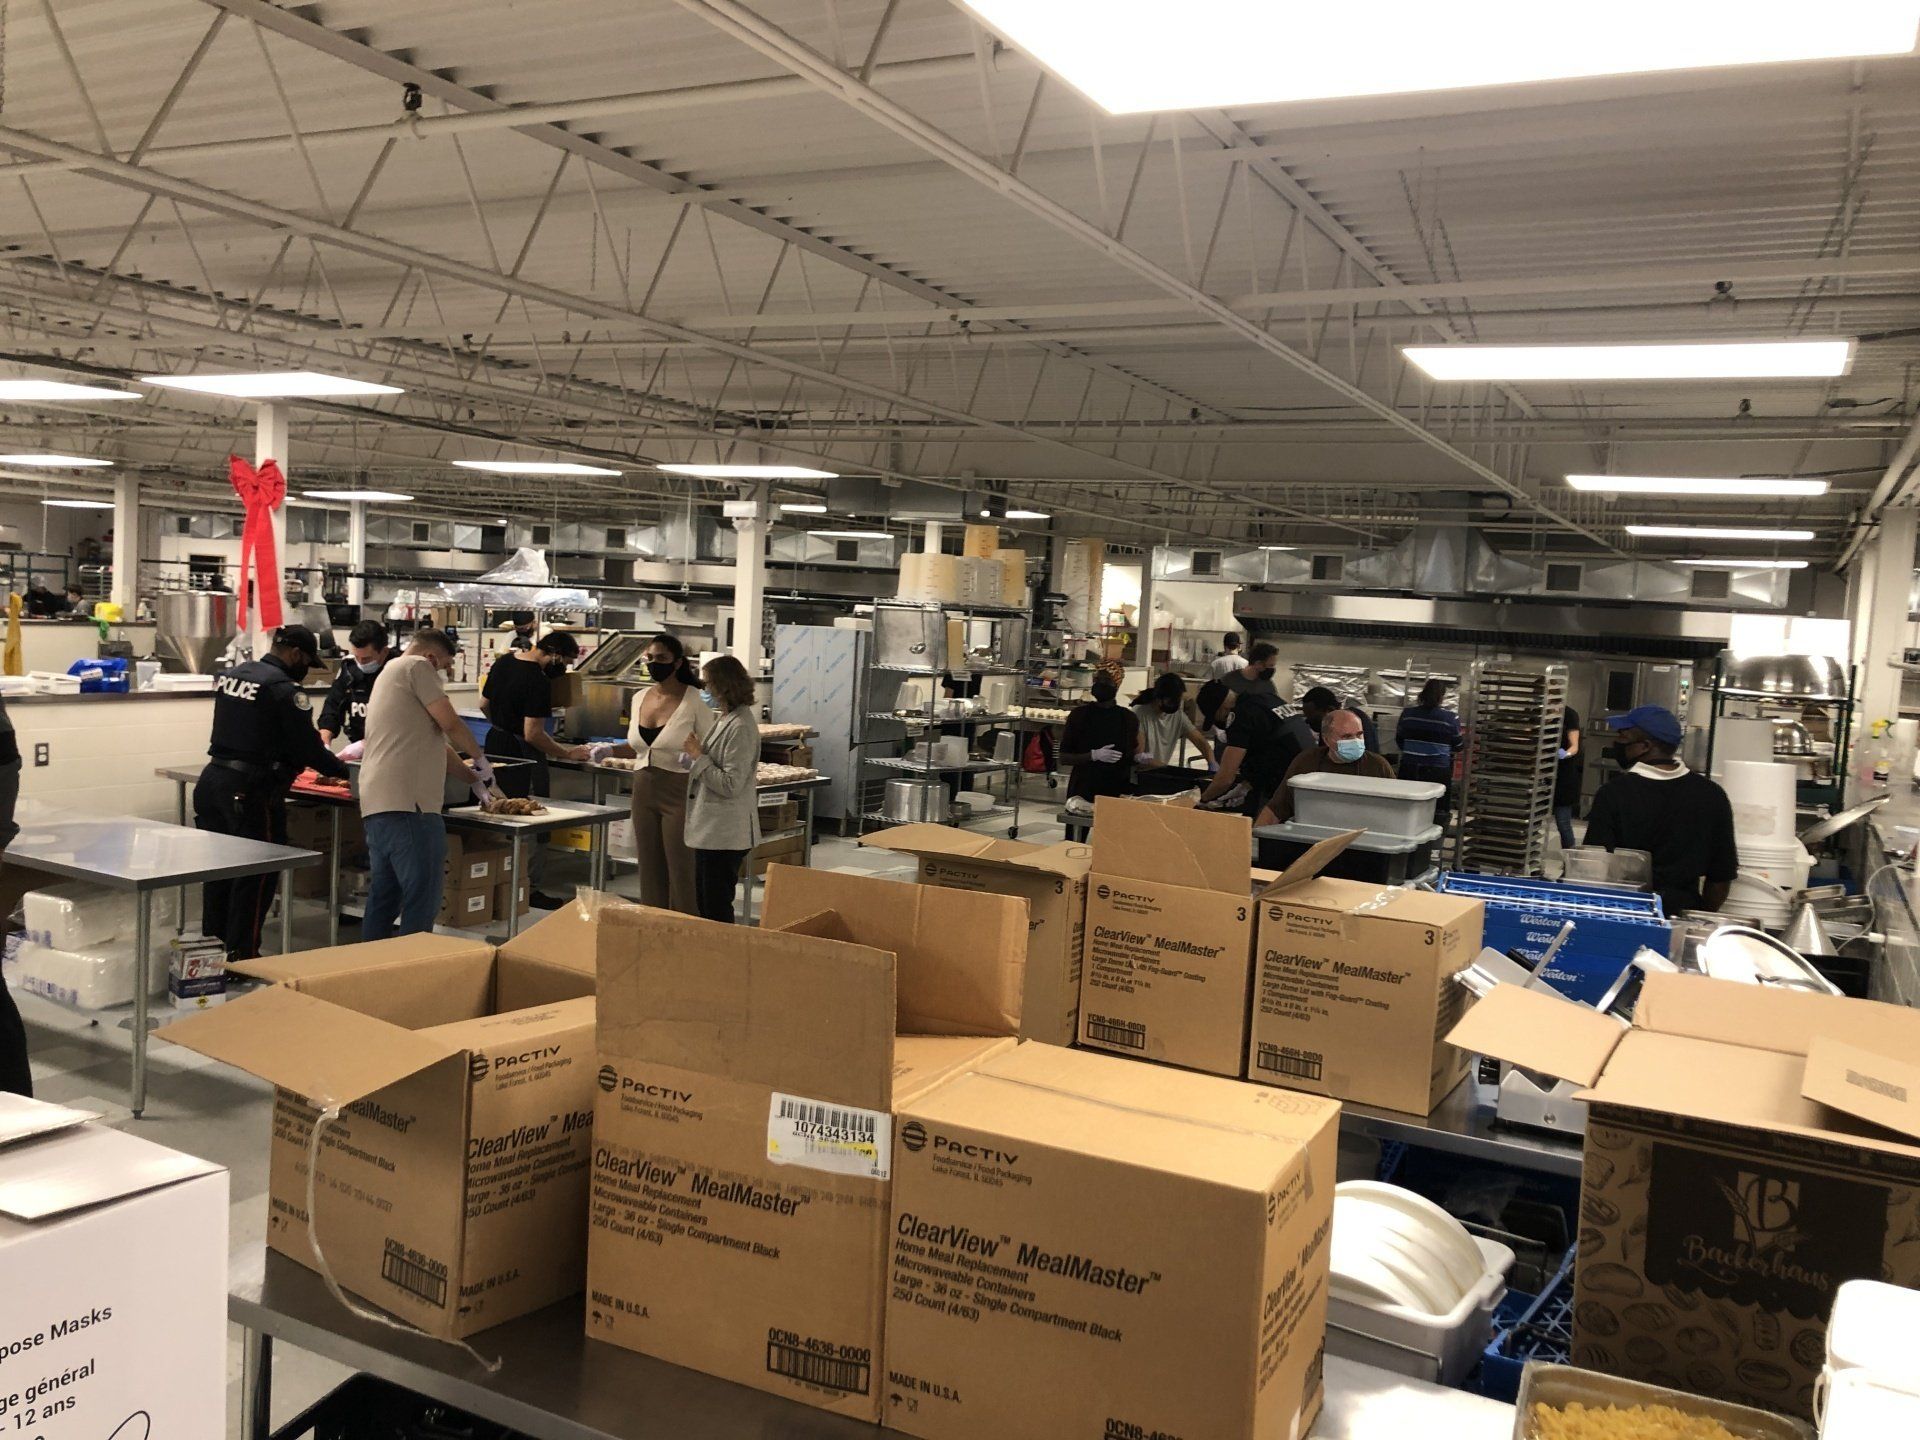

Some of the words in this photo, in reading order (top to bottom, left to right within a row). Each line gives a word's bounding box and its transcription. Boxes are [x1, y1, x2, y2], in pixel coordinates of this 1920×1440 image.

[214, 676, 260, 700] POLICE
[939, 867, 979, 879] PACTIV
[1055, 880, 1063, 894] 3
[1113, 890, 1156, 903] PACTIV
[1236, 906, 1247, 922] 3
[1286, 911, 1333, 926] PACTIV
[1520, 913, 1561, 928] Weston
[1424, 929, 1435, 946] 3
[495, 1045, 561, 1070] PACTIV
[622, 1077, 692, 1103] PACTIV
[794, 1119, 875, 1145] 1074343134
[934, 1135, 1019, 1165] PACTIV
[618, 1177, 640, 1194] Meal
[642, 1183, 702, 1209] Replacement
[659, 1203, 708, 1227] Containers
[593, 1200, 616, 1216] Large
[687, 1224, 751, 1253] Compartment
[752, 1241, 781, 1259] Black
[610, 1219, 635, 1237] Count
[895, 1237, 926, 1257] Home
[927, 1245, 955, 1264] Meal
[956, 1253, 1029, 1284] Replacement
[894, 1254, 974, 1286] Microwaveable
[976, 1275, 1036, 1302] Containers
[892, 1286, 913, 1303] 250
[914, 1292, 946, 1312] Count
[947, 1302, 980, 1324] (4/63)
[893, 1270, 923, 1290] Large
[933, 1281, 947, 1296] 36
[949, 1288, 963, 1300] oz
[972, 1290, 1008, 1313] Single
[1010, 1301, 1088, 1333] Compartment
[1089, 1322, 1123, 1343] Black
[51, 1306, 112, 1341] Masks
[26, 1358, 95, 1404] général
[889, 1371, 917, 1391] MADE
[919, 1380, 931, 1395] IN
[14, 1408, 37, 1430] 12
[43, 1395, 77, 1419] ans
